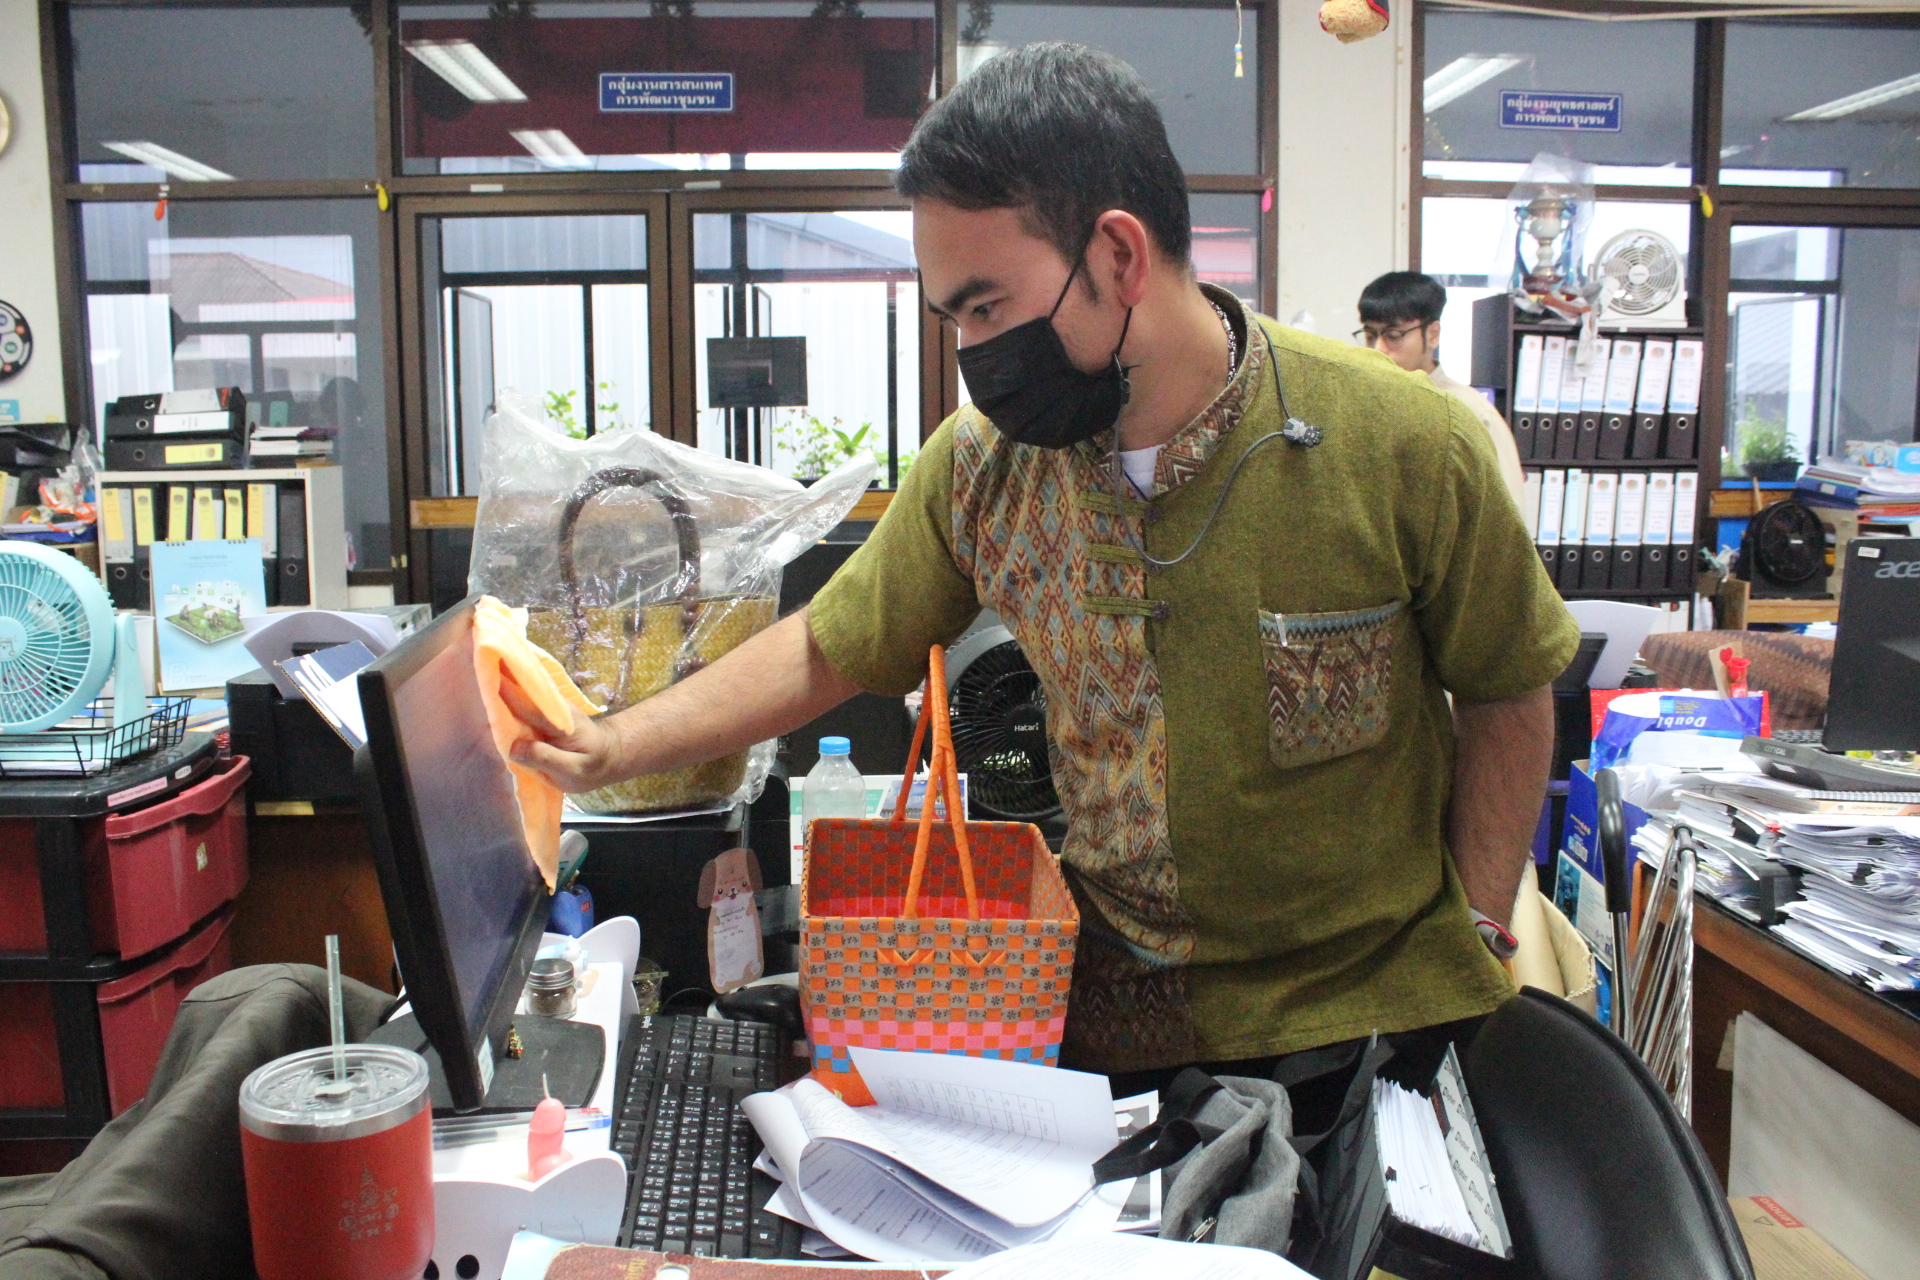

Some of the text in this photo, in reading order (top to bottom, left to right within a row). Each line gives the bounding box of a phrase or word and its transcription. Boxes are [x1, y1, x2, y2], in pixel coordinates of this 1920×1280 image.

[608, 77, 723, 95] กลุ่มงานสารสนเทศ
[616, 92, 715, 109] การพัฒนาชุมชน
[1507, 93, 1615, 113] กลุ่มงานยุทธศาสตร์
[1515, 110, 1605, 128] การพัฒนาชุมชน
[1014, 722, 1039, 732] Hatari
